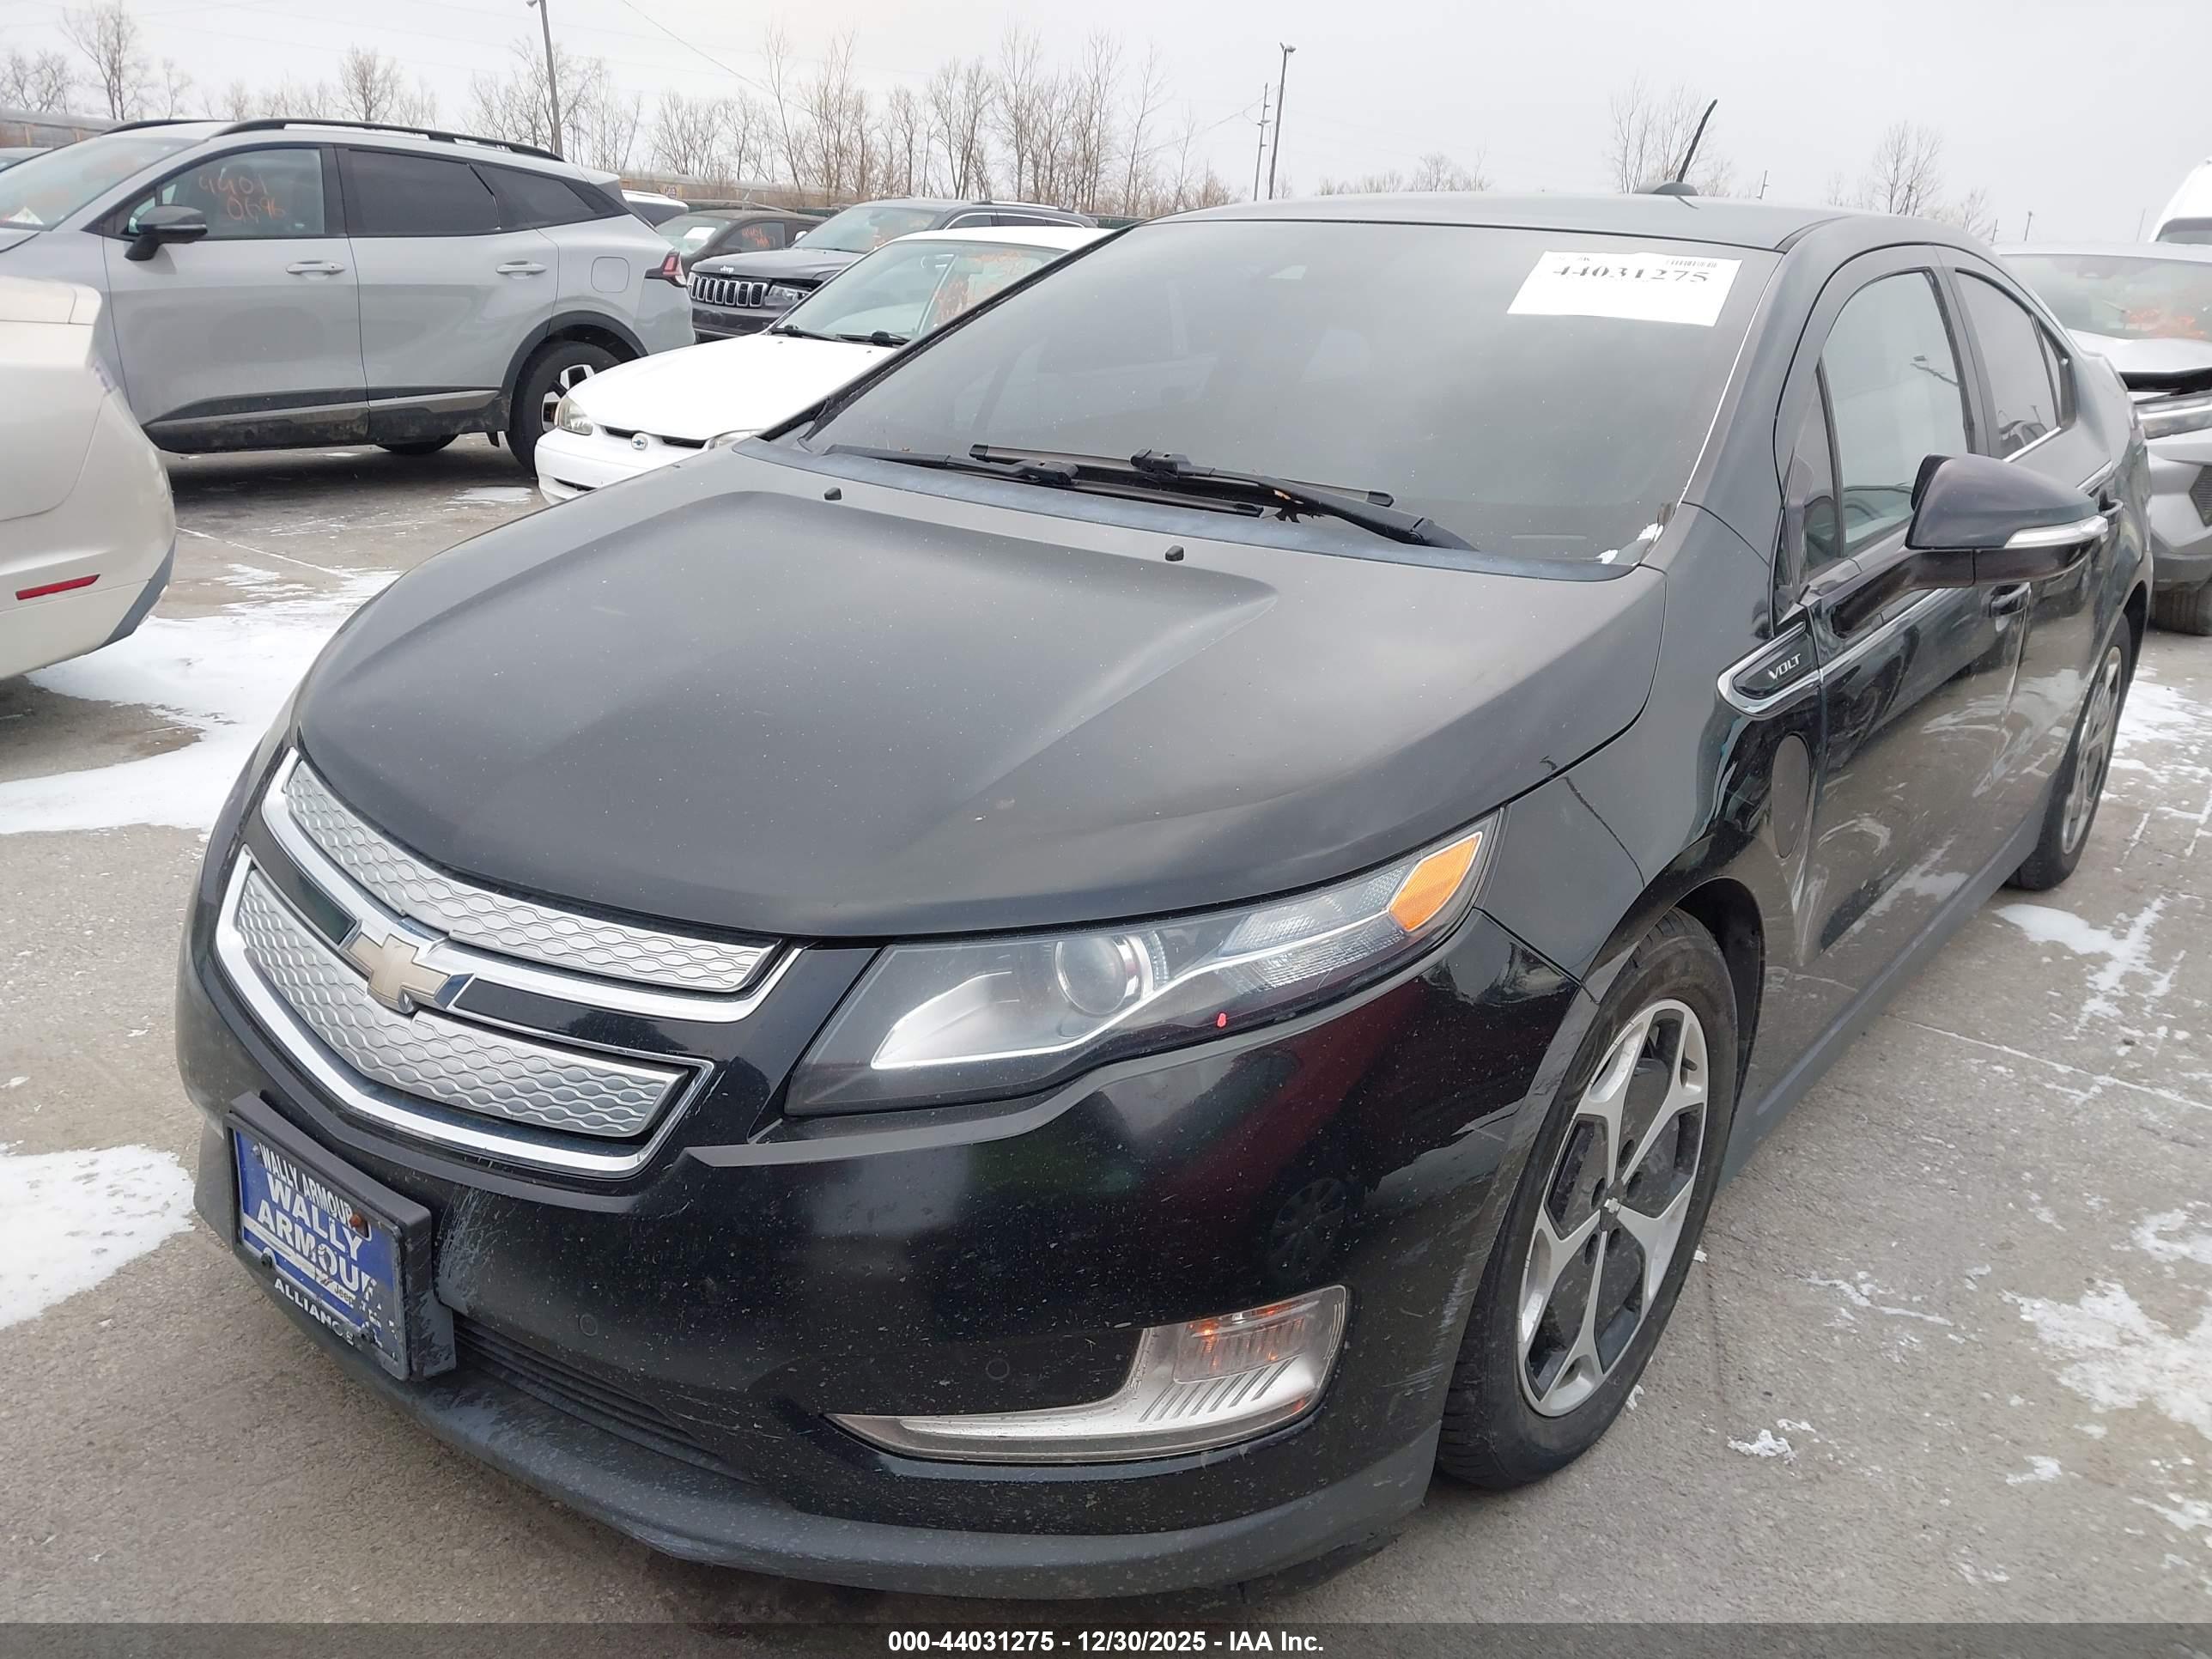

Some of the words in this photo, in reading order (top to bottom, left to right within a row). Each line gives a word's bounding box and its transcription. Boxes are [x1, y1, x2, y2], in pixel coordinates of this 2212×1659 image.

[1553, 265, 1710, 283] 44031275
[1767, 653, 1802, 680] VOLT
[258, 1142, 300, 1192] WALLY
[267, 1172, 362, 1261] WALLY
[274, 1278, 356, 1346] ALLIANCE
